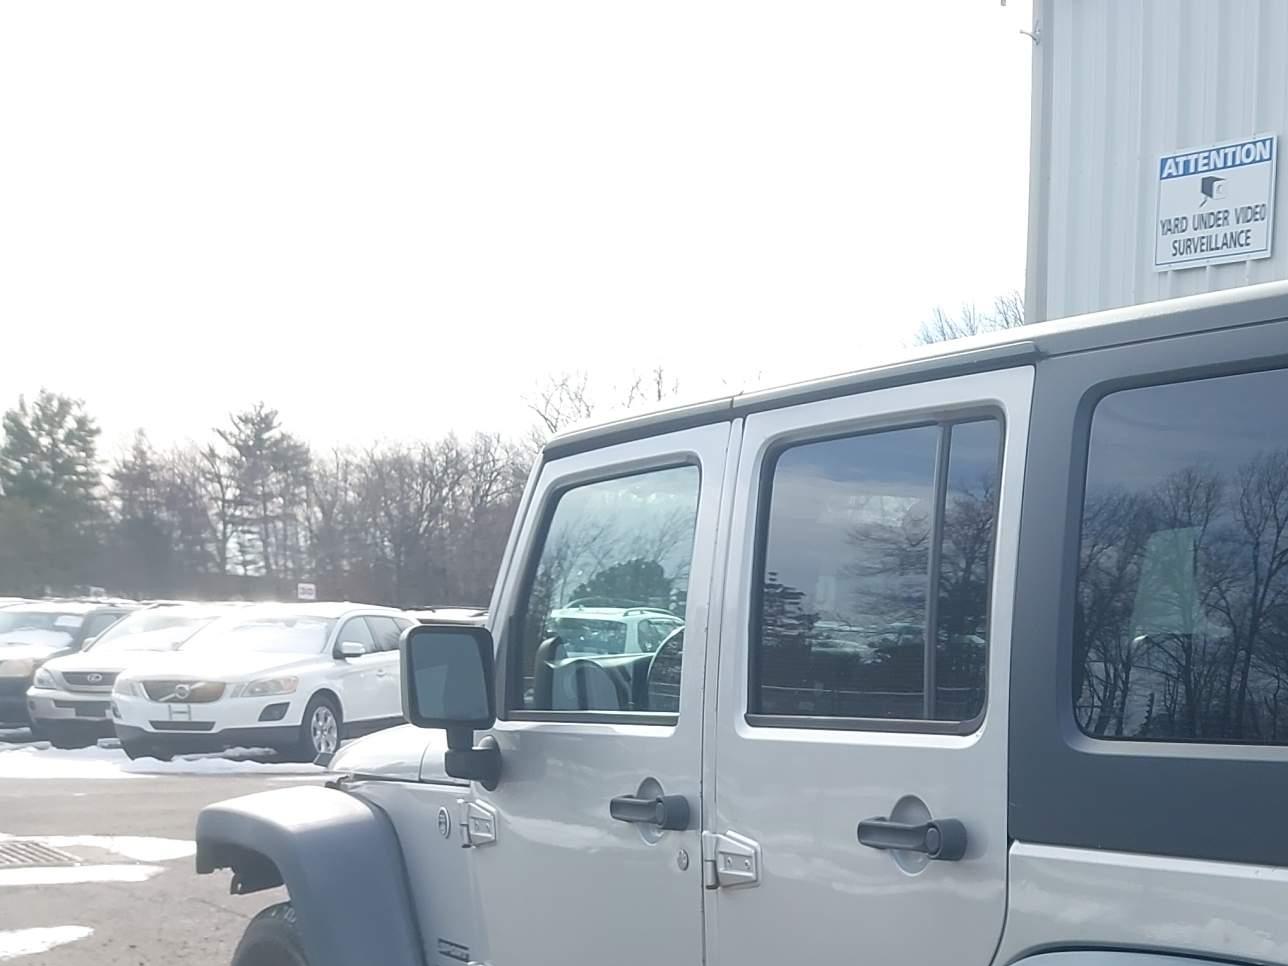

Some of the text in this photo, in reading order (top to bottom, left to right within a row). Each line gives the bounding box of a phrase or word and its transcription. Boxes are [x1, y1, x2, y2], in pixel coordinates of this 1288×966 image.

[1161, 139, 1271, 178] ATTENTION
[1160, 203, 1266, 236] YARD UNDER VIDEO
[1171, 229, 1252, 257] SURVEILLANCE
